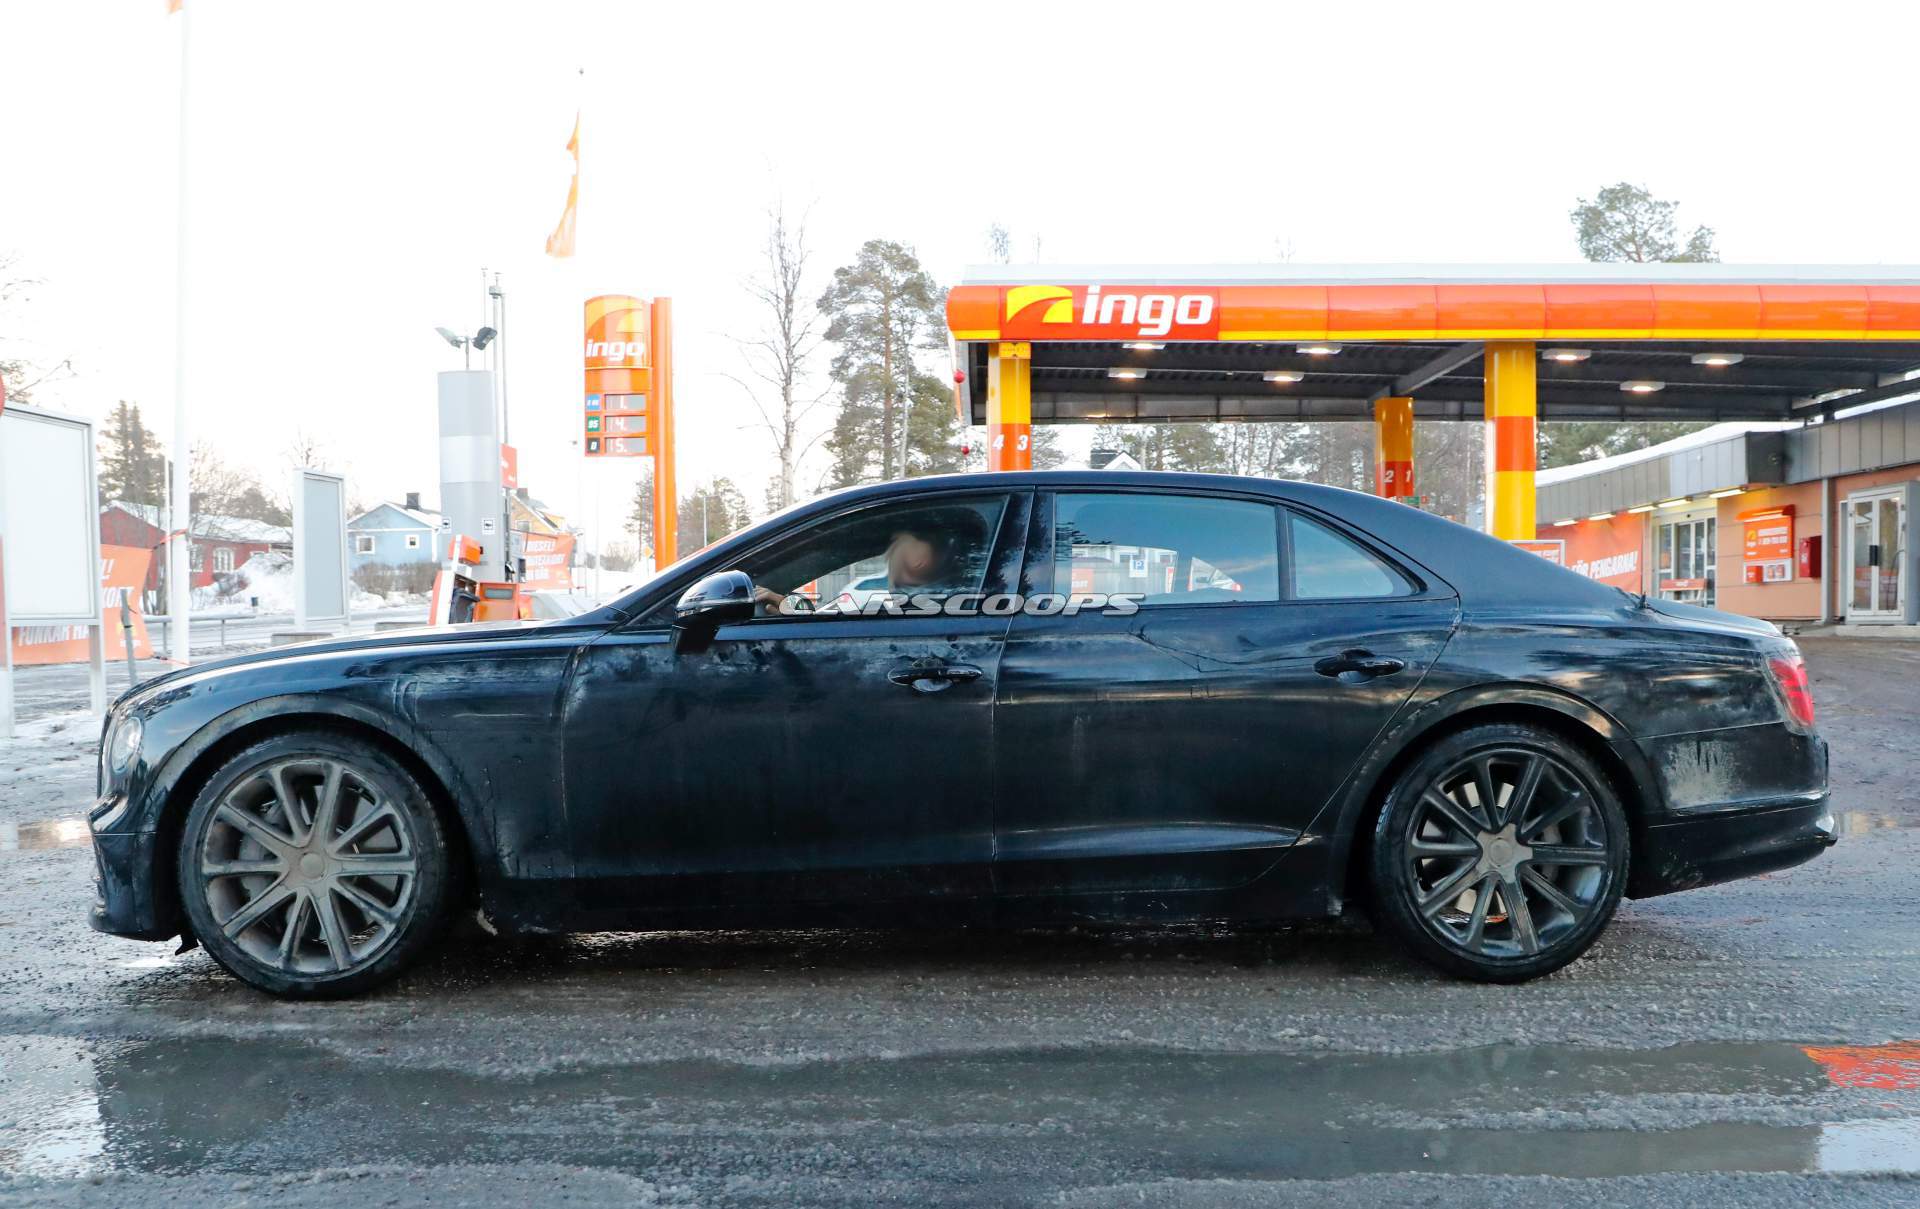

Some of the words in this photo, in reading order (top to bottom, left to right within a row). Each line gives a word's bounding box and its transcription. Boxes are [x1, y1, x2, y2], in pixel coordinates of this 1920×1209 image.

[1082, 285, 1214, 336] ingo
[586, 339, 642, 362] ingo
[992, 434, 1004, 451] 4
[1016, 435, 1029, 451] 3
[1383, 470, 1394, 483] 2
[1405, 470, 1412, 483] 1
